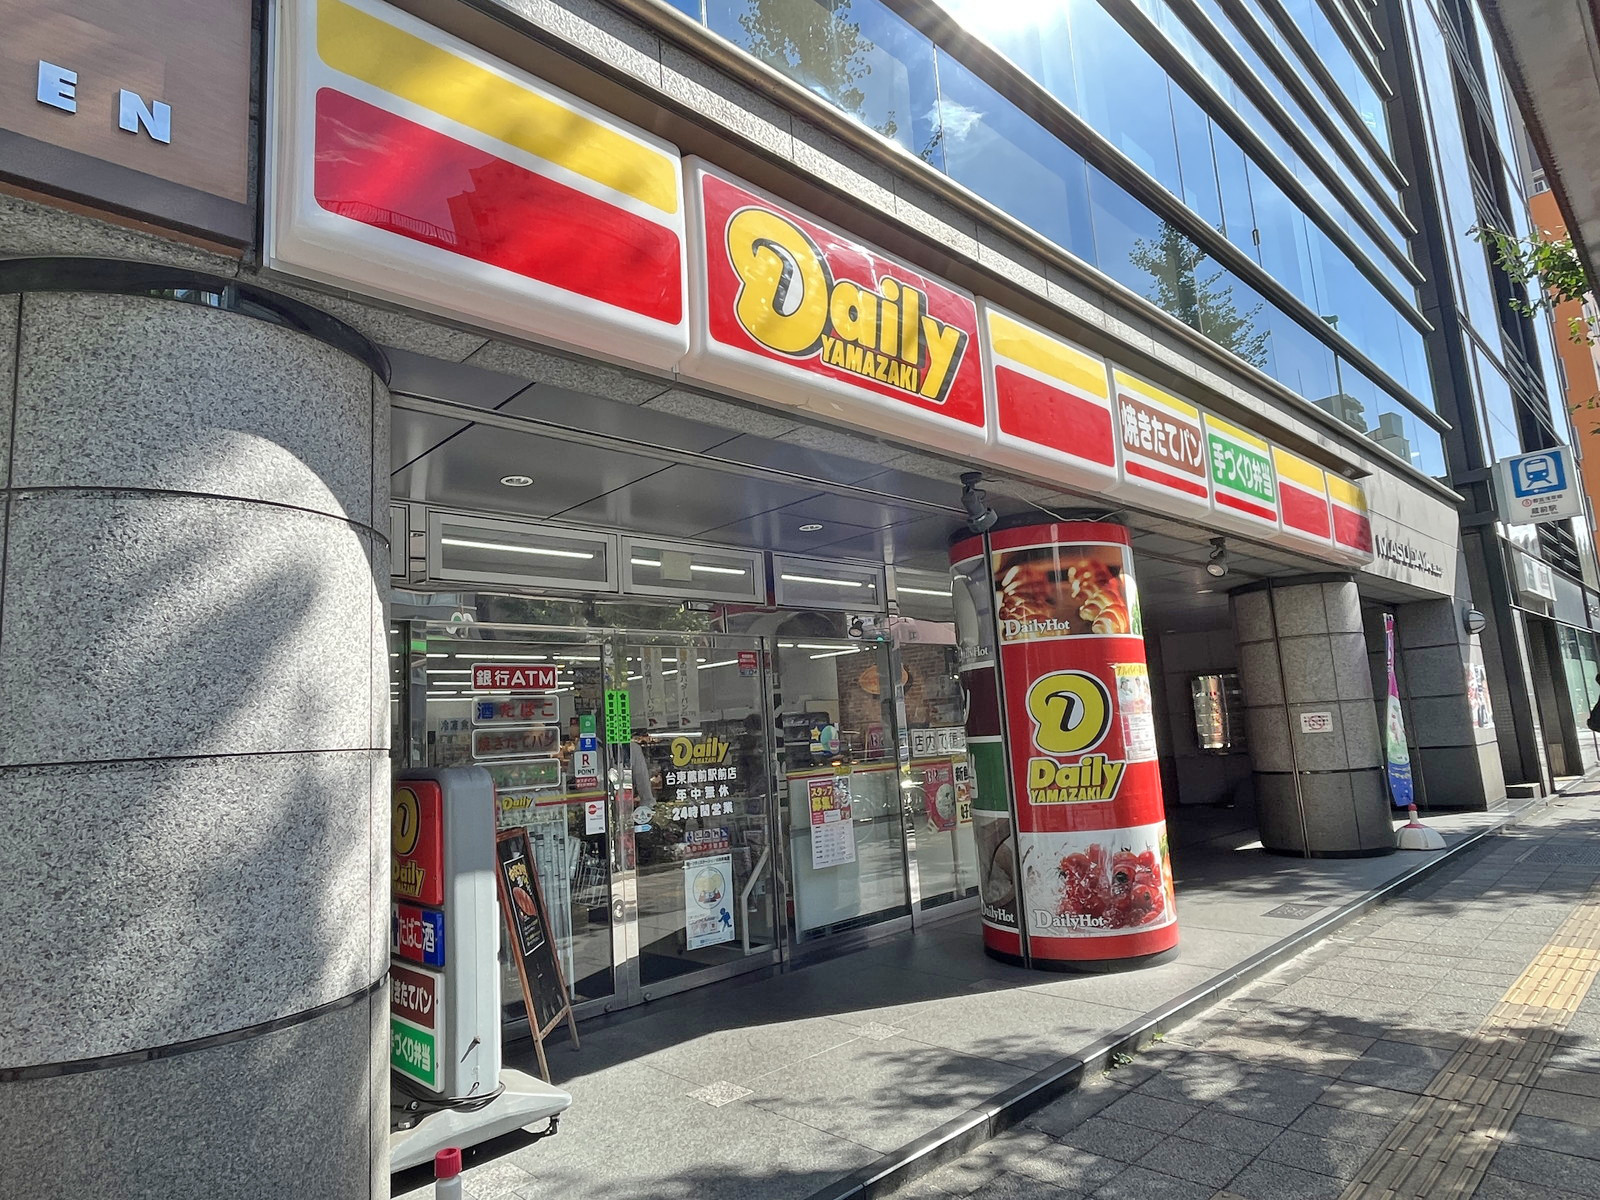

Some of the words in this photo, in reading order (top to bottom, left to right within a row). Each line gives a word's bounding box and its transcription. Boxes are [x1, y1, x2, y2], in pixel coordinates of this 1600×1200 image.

[727, 208, 968, 402] Daily
[821, 334, 919, 393] YAMAZAKI
[1121, 401, 1202, 467] 焼きたてパン
[1212, 442, 1273, 497] 手づくり弁当
[1005, 618, 1070, 636] DailyHot
[476, 670, 554, 686] 銀行ATM
[582, 754, 590, 766] R
[671, 736, 730, 767] Daily
[666, 767, 737, 785] 台東蔵前駅前店
[1030, 756, 1124, 799] Daily
[676, 784, 729, 801] 年中無休
[811, 786, 832, 797] スタッフ
[1031, 788, 1101, 803] YAMAZAKI
[502, 796, 533, 811] Daily
[672, 801, 733, 820] 24時間営業
[1034, 909, 1105, 929] DailyHot
[399, 914, 423, 949] たばこ
[423, 921, 434, 953] 酒
